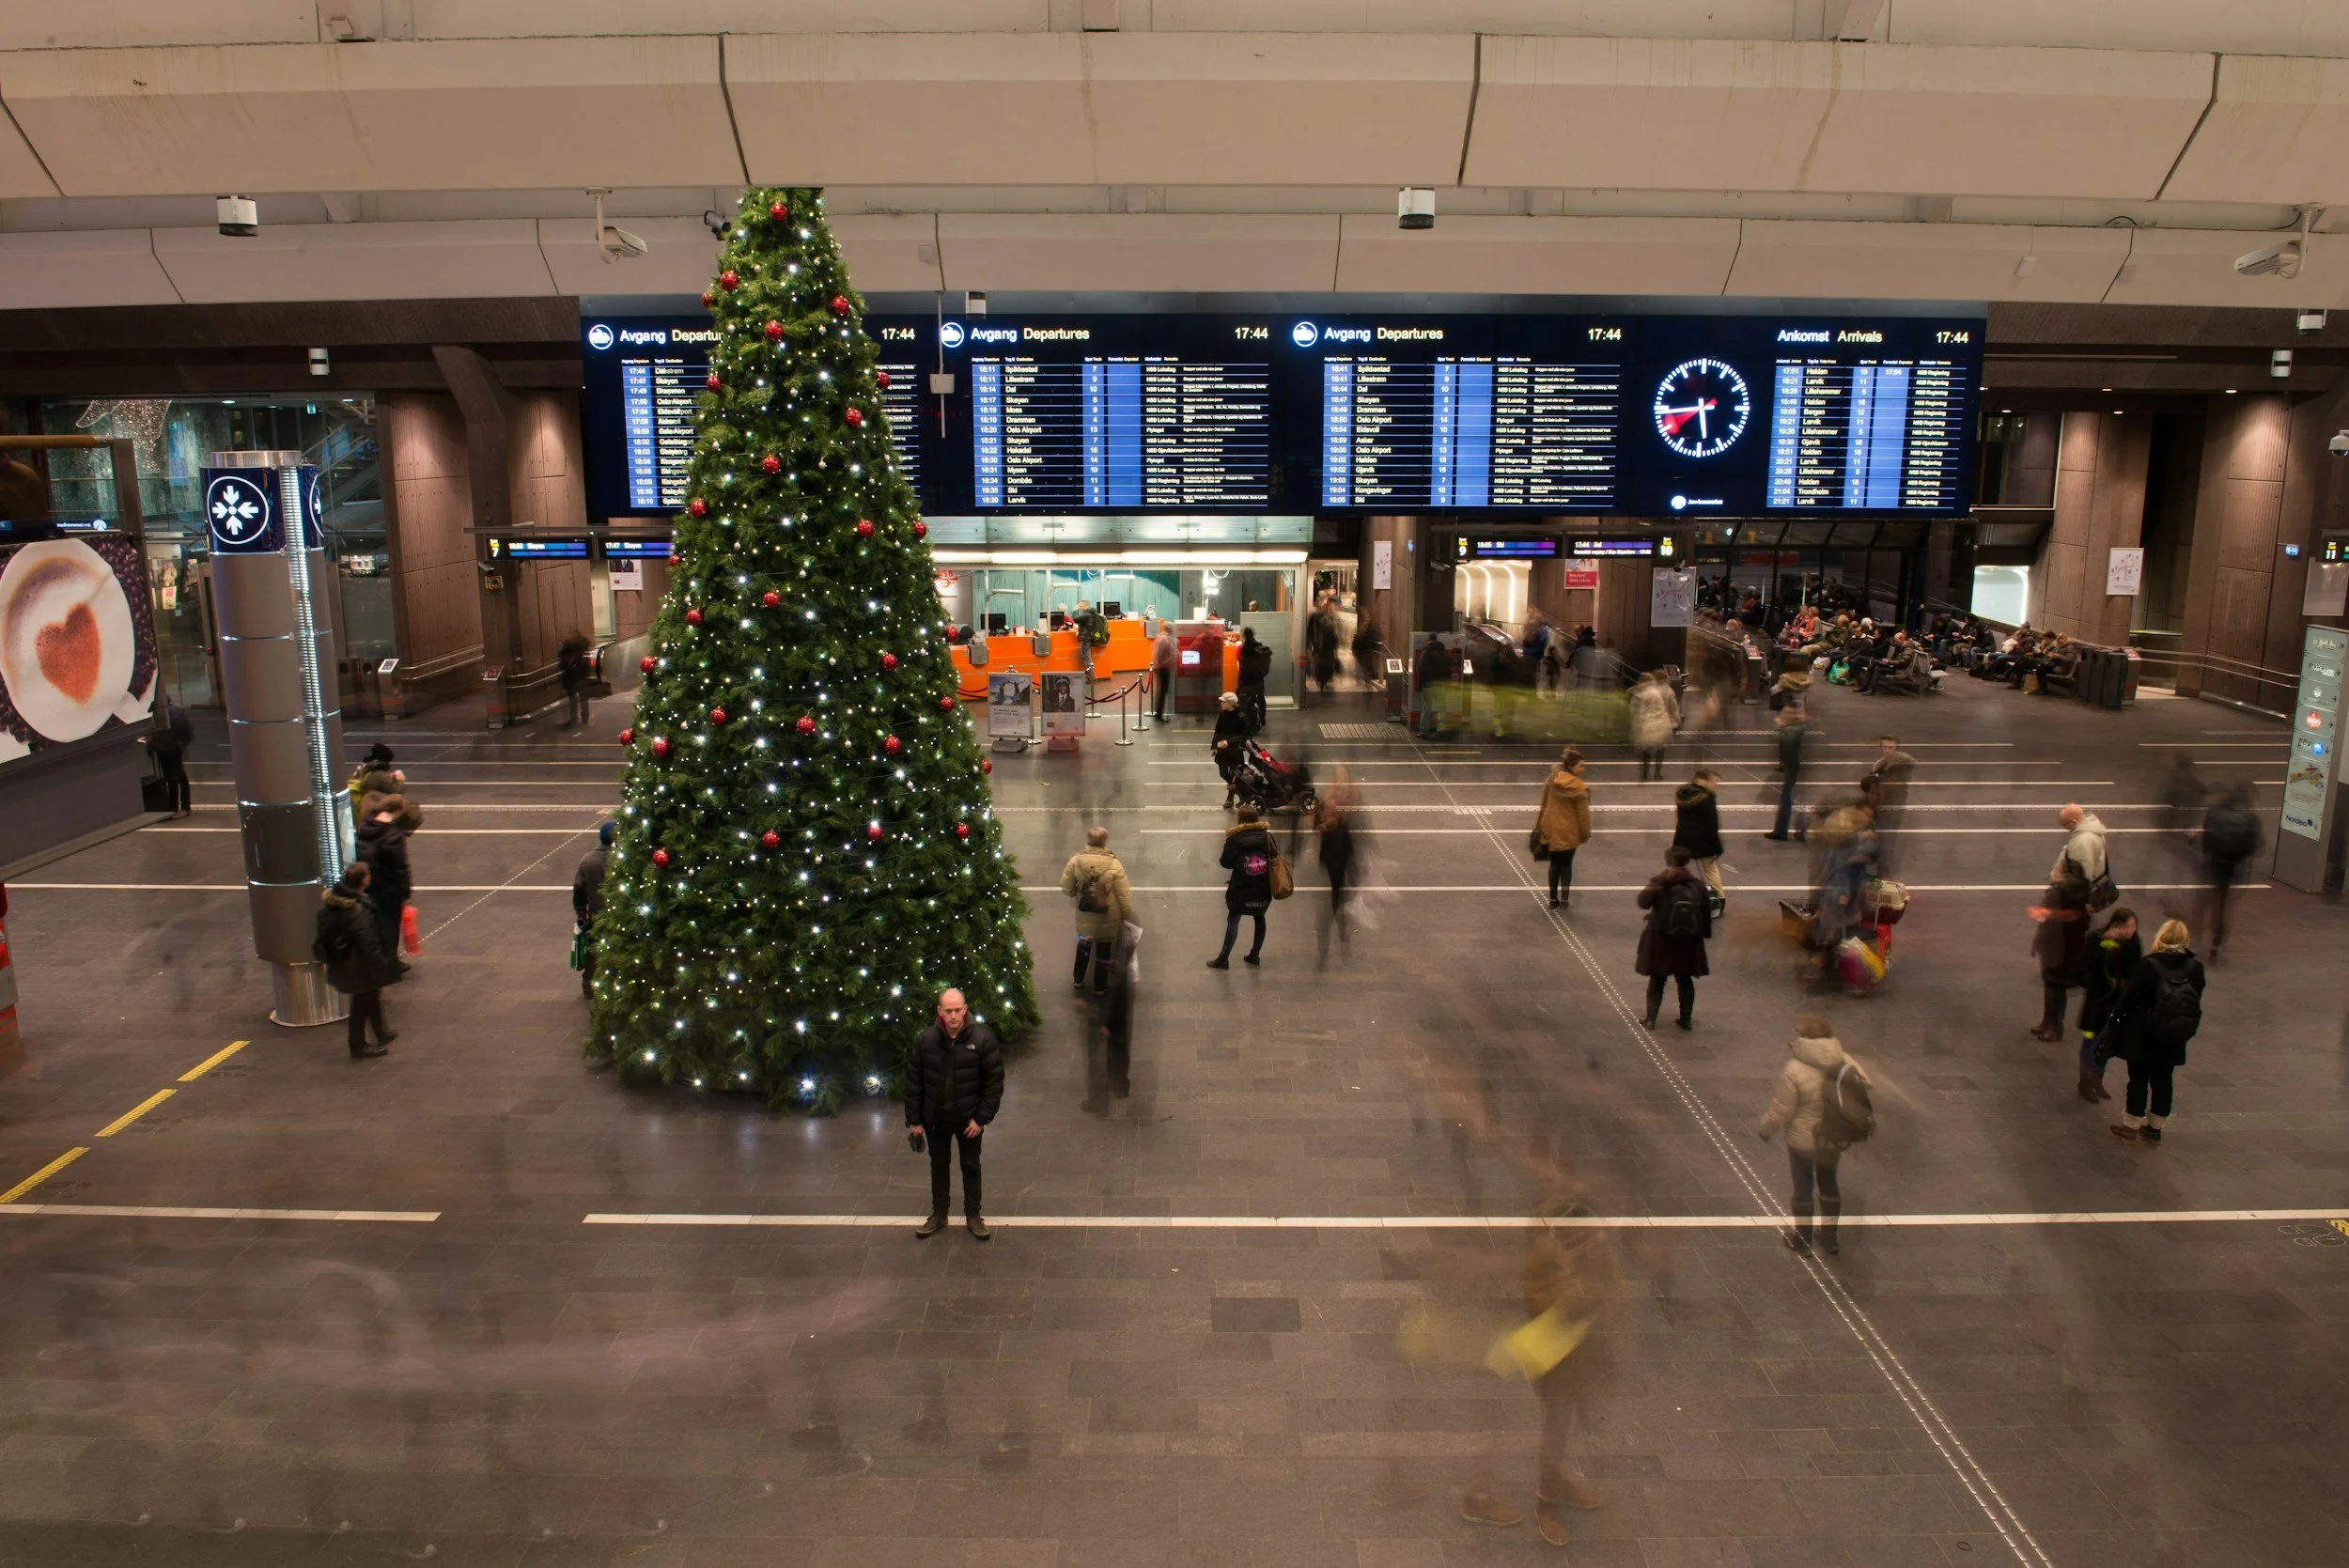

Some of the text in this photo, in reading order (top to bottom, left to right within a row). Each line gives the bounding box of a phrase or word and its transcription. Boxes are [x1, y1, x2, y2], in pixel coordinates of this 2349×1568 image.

[620, 330, 723, 344] Avgang Departur
[882, 329, 914, 339] 17:44
[972, 328, 1089, 342] Avgang Departures
[1236, 328, 1268, 338] 17:44
[1325, 328, 1443, 342] Avgang Departures
[1589, 329, 1621, 340] 17:44
[1778, 330, 1882, 342] Ankomst Arrivals
[1937, 332, 1968, 343] 17:44
[1330, 365, 1348, 373] 18:41
[1004, 384, 1017, 393] Dal
[1372, 415, 1392, 424] Airport
[1802, 416, 1822, 425] Larvik
[1021, 425, 1042, 434] Airport
[1022, 456, 1043, 464] Airport
[1797, 496, 1816, 505] Larvik
[492, 547, 500, 558] 7
[1459, 545, 1467, 555] 9
[1661, 545, 1672, 555] 10
[2326, 550, 2337, 560] 11
